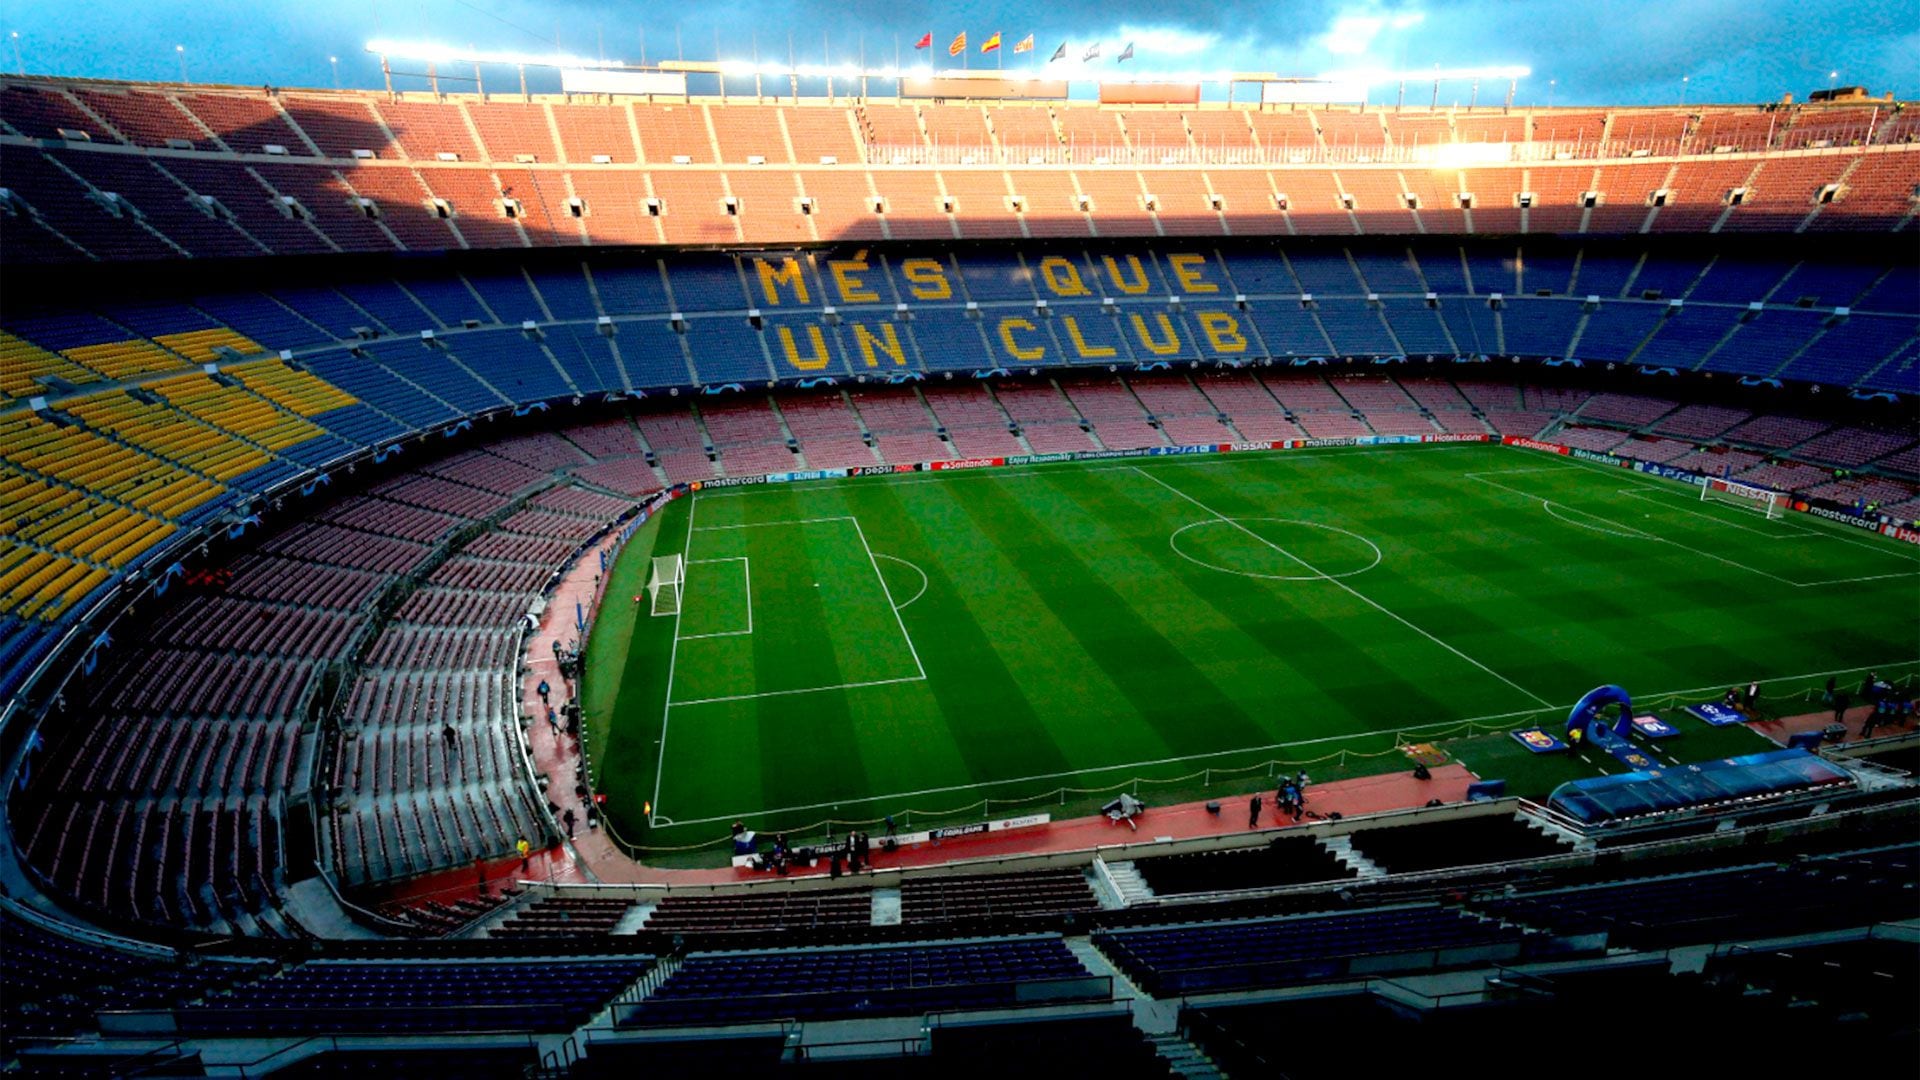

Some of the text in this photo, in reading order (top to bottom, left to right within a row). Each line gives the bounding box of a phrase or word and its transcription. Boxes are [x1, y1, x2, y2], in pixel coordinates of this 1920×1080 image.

[754, 249, 1219, 304] MÉS QUE
[776, 310, 1249, 371] UN CLUB
[1230, 440, 1272, 451] NISSAN
[1305, 437, 1355, 447] mastercard
[1434, 433, 1482, 443] Hotels.com
[1520, 438, 1561, 453] Santander
[949, 458, 994, 470] Santander
[1573, 448, 1621, 466] Heineken
[864, 465, 893, 476] pepsi
[703, 474, 766, 489] mastercard
[1725, 484, 1776, 503] NISSAN
[1809, 505, 1878, 531] mastercard
